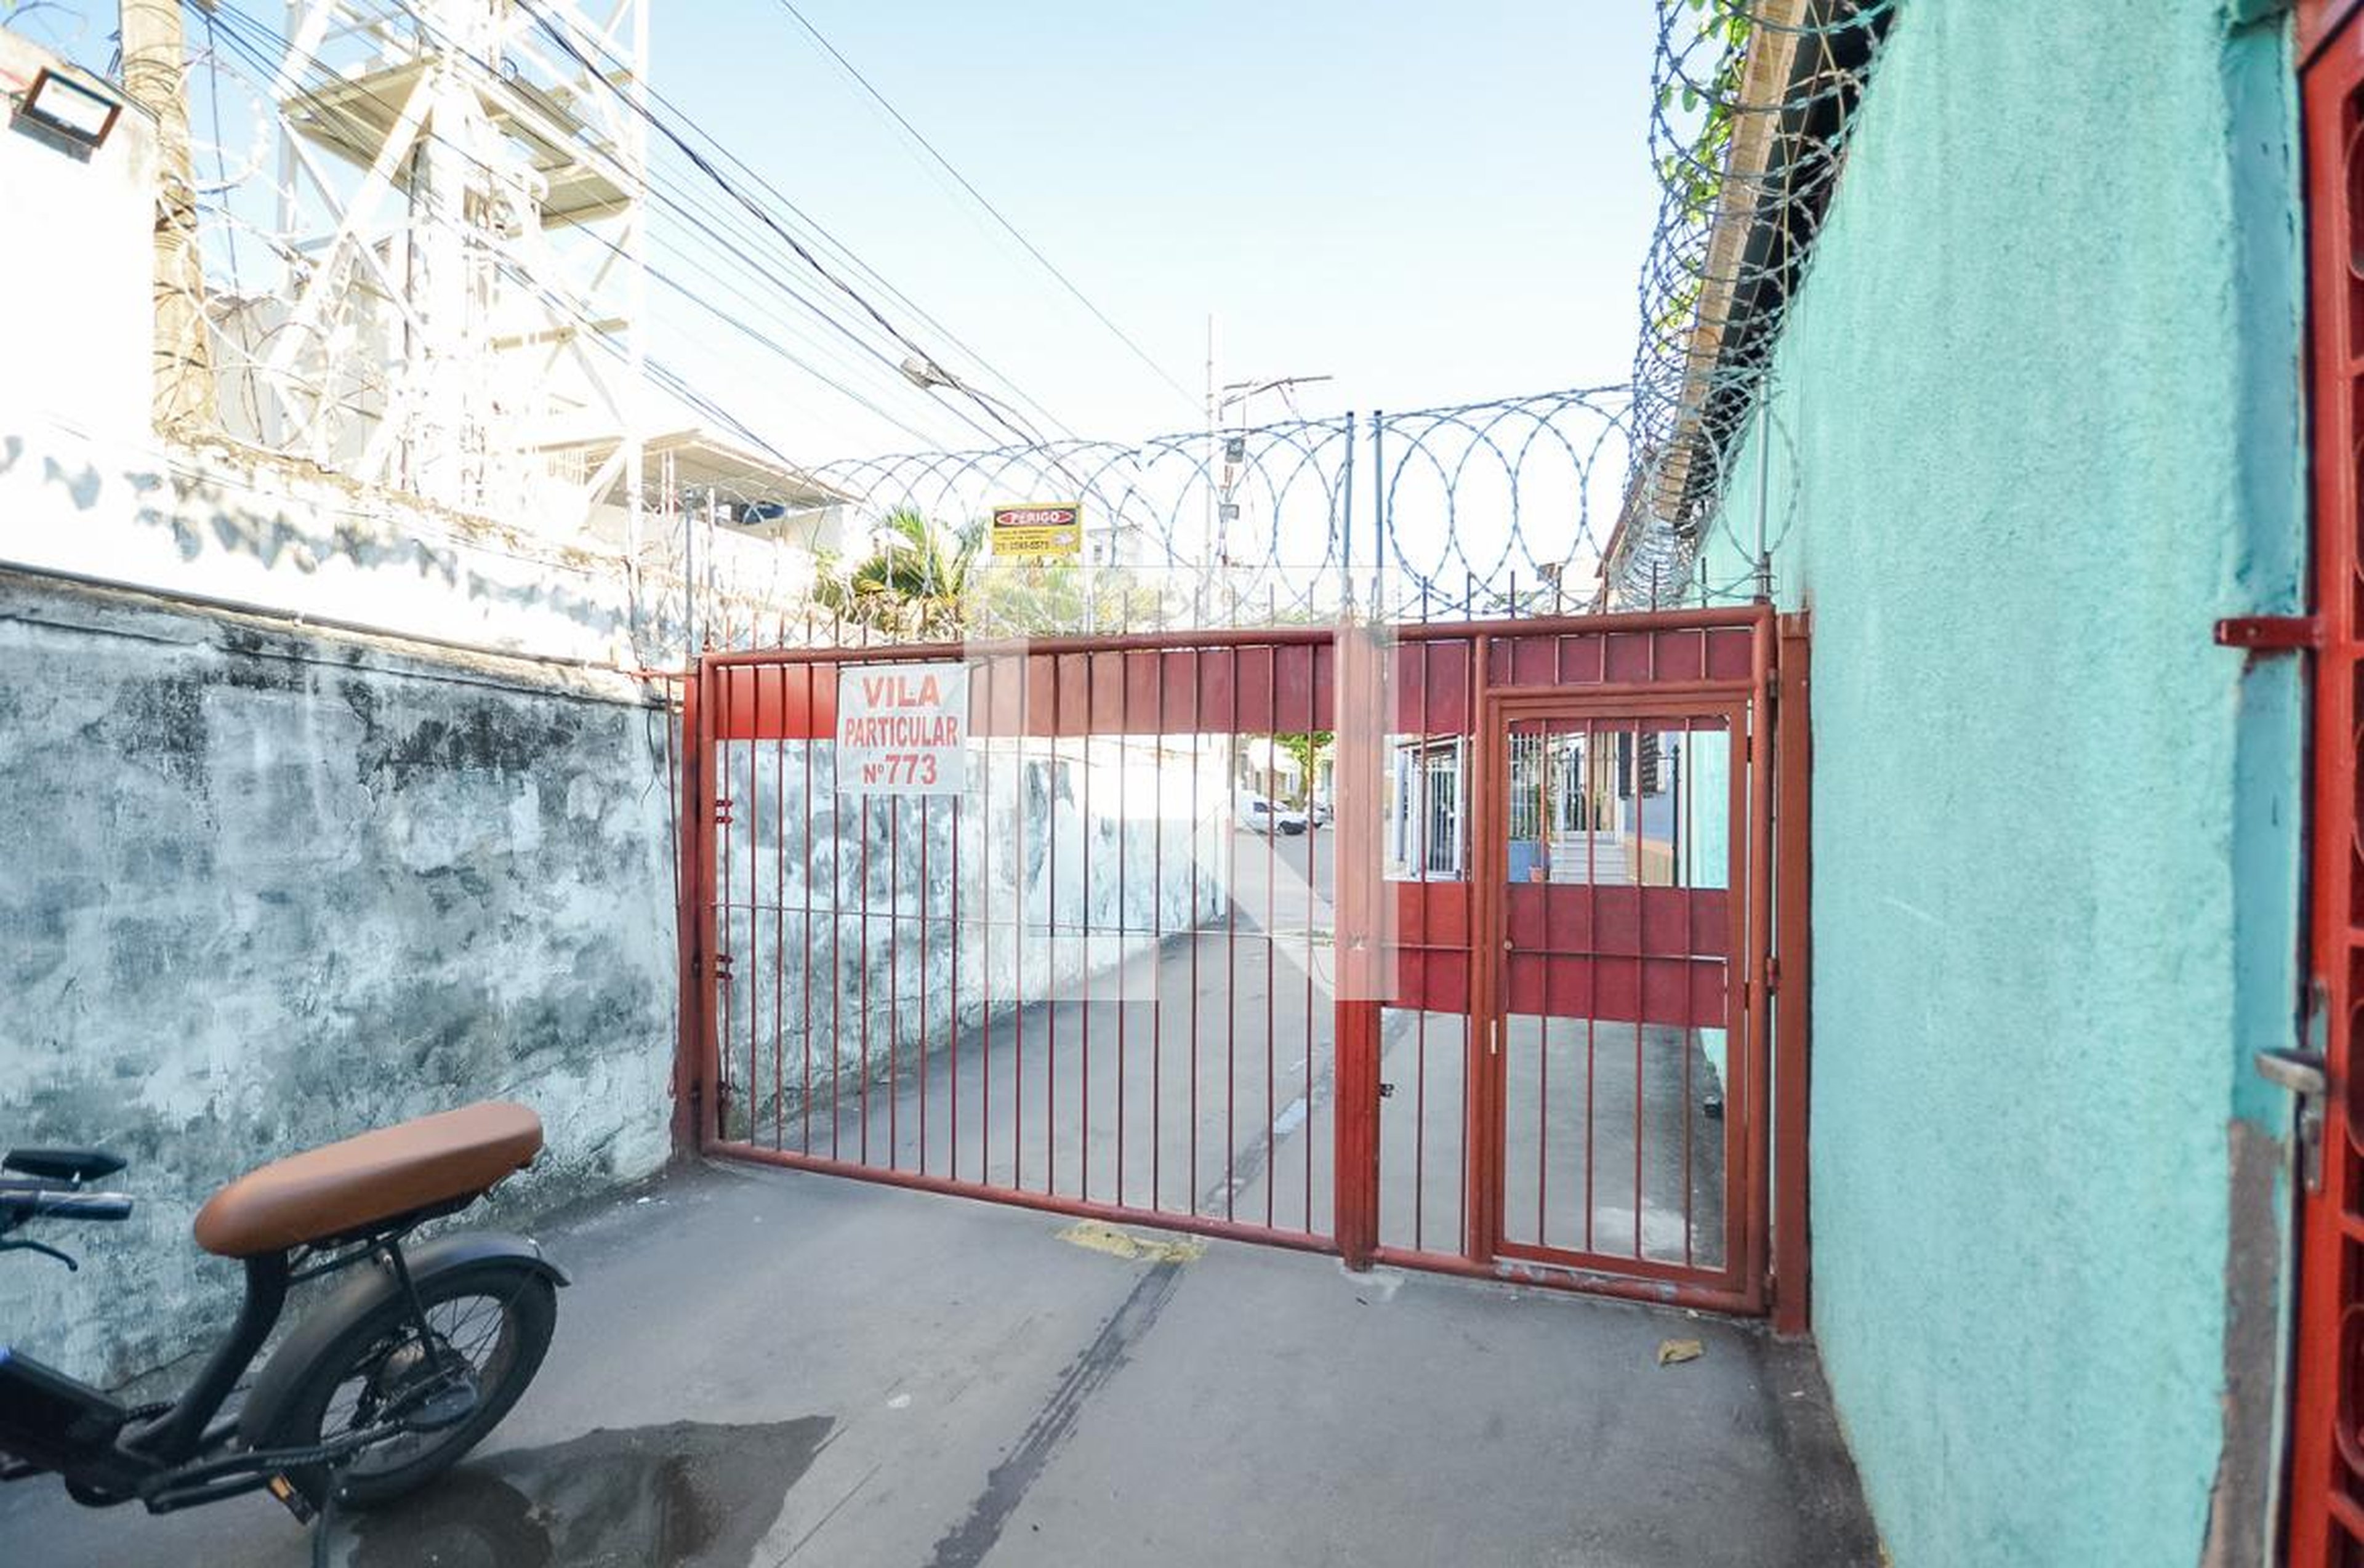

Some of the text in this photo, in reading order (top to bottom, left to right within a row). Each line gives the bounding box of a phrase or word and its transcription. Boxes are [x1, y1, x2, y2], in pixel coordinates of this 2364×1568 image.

[1010, 511, 1059, 524] PERIGO
[862, 675, 940, 707] VILA
[844, 716, 958, 747] PARTICULAR
